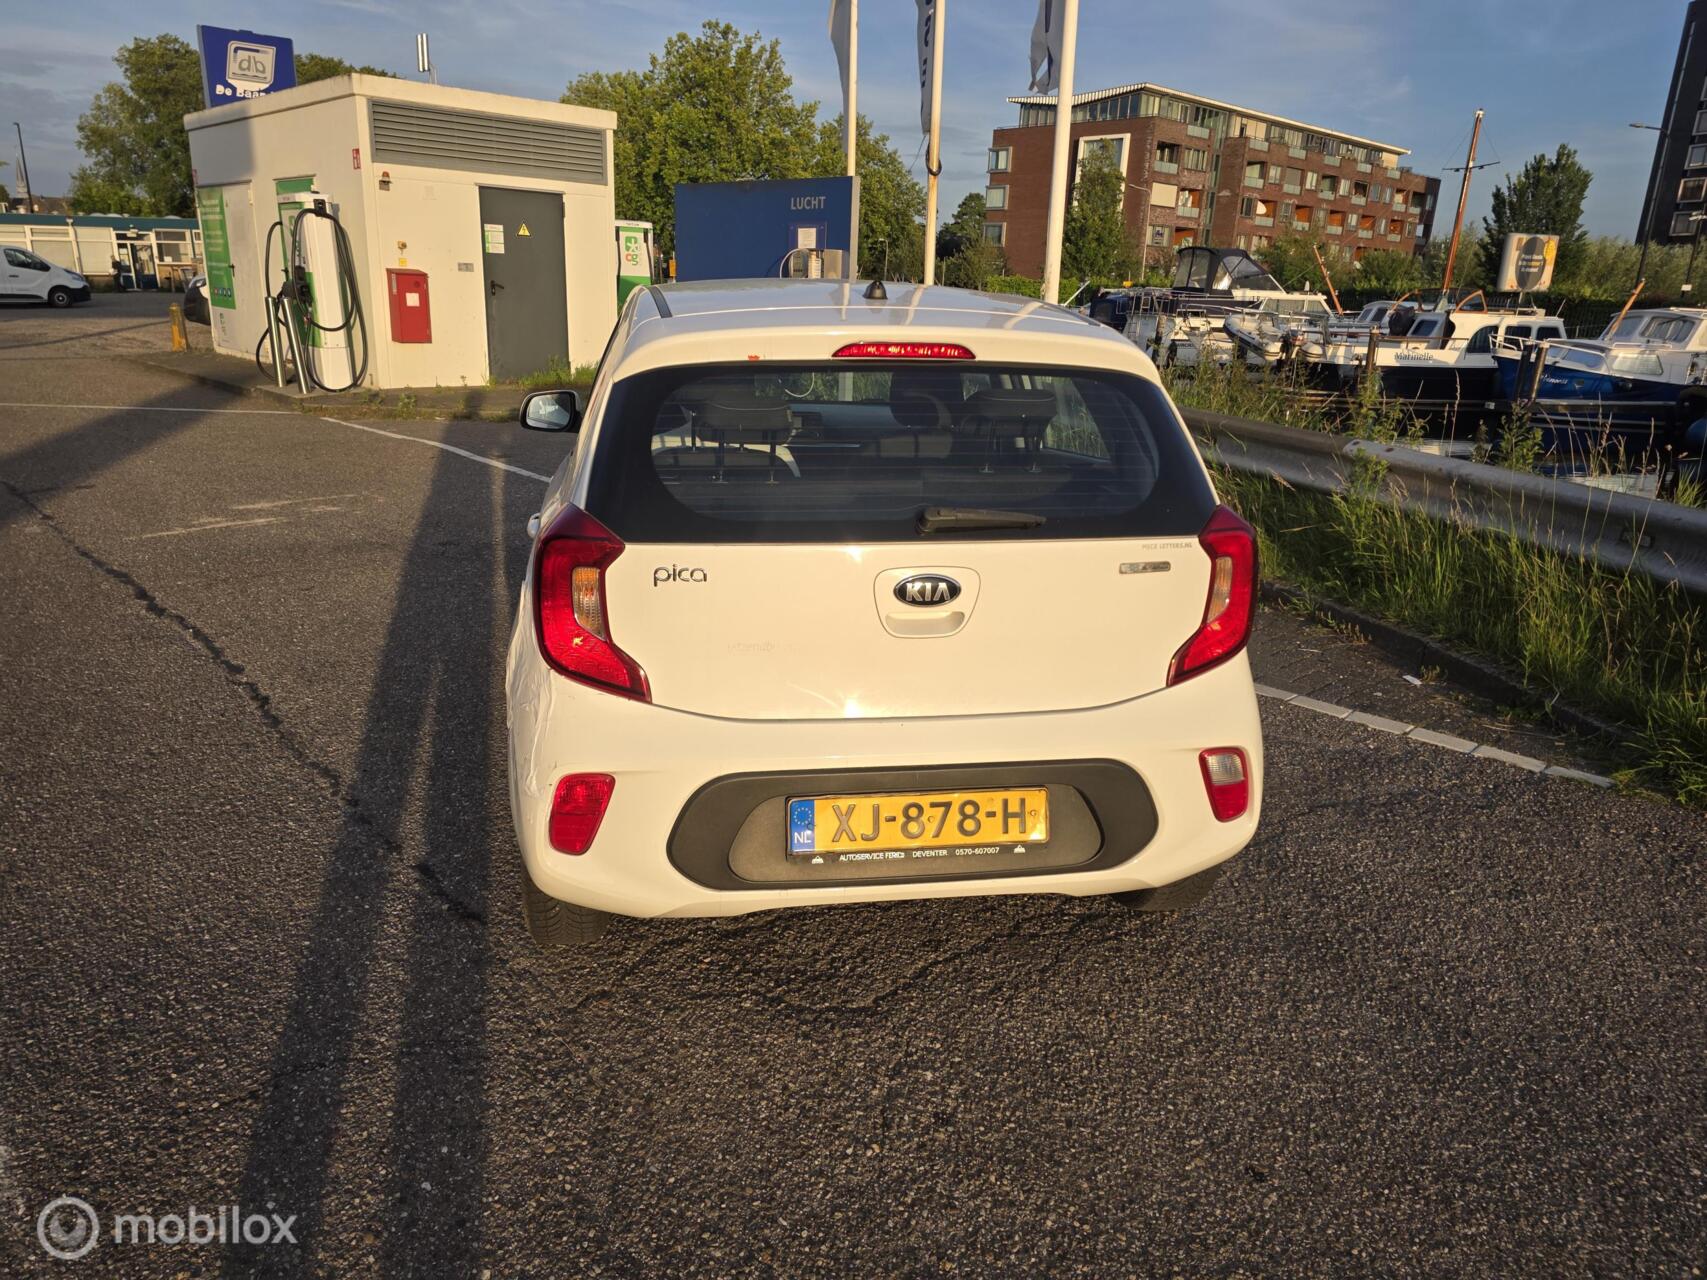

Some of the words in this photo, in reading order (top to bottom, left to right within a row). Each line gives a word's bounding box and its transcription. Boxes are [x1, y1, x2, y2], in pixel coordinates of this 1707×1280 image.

[215, 84, 232, 96] De
[791, 196, 827, 210] LUCHT
[1394, 351, 1434, 361] Marinelle
[653, 563, 708, 588] pica
[905, 582, 951, 602] KIA
[832, 797, 1027, 843] XJ-878-H
[794, 831, 812, 844] NL
[839, 852, 884, 861] AUTOSERVICE
[912, 849, 948, 858] DEVENTER
[955, 847, 1000, 856] 0570-607007
